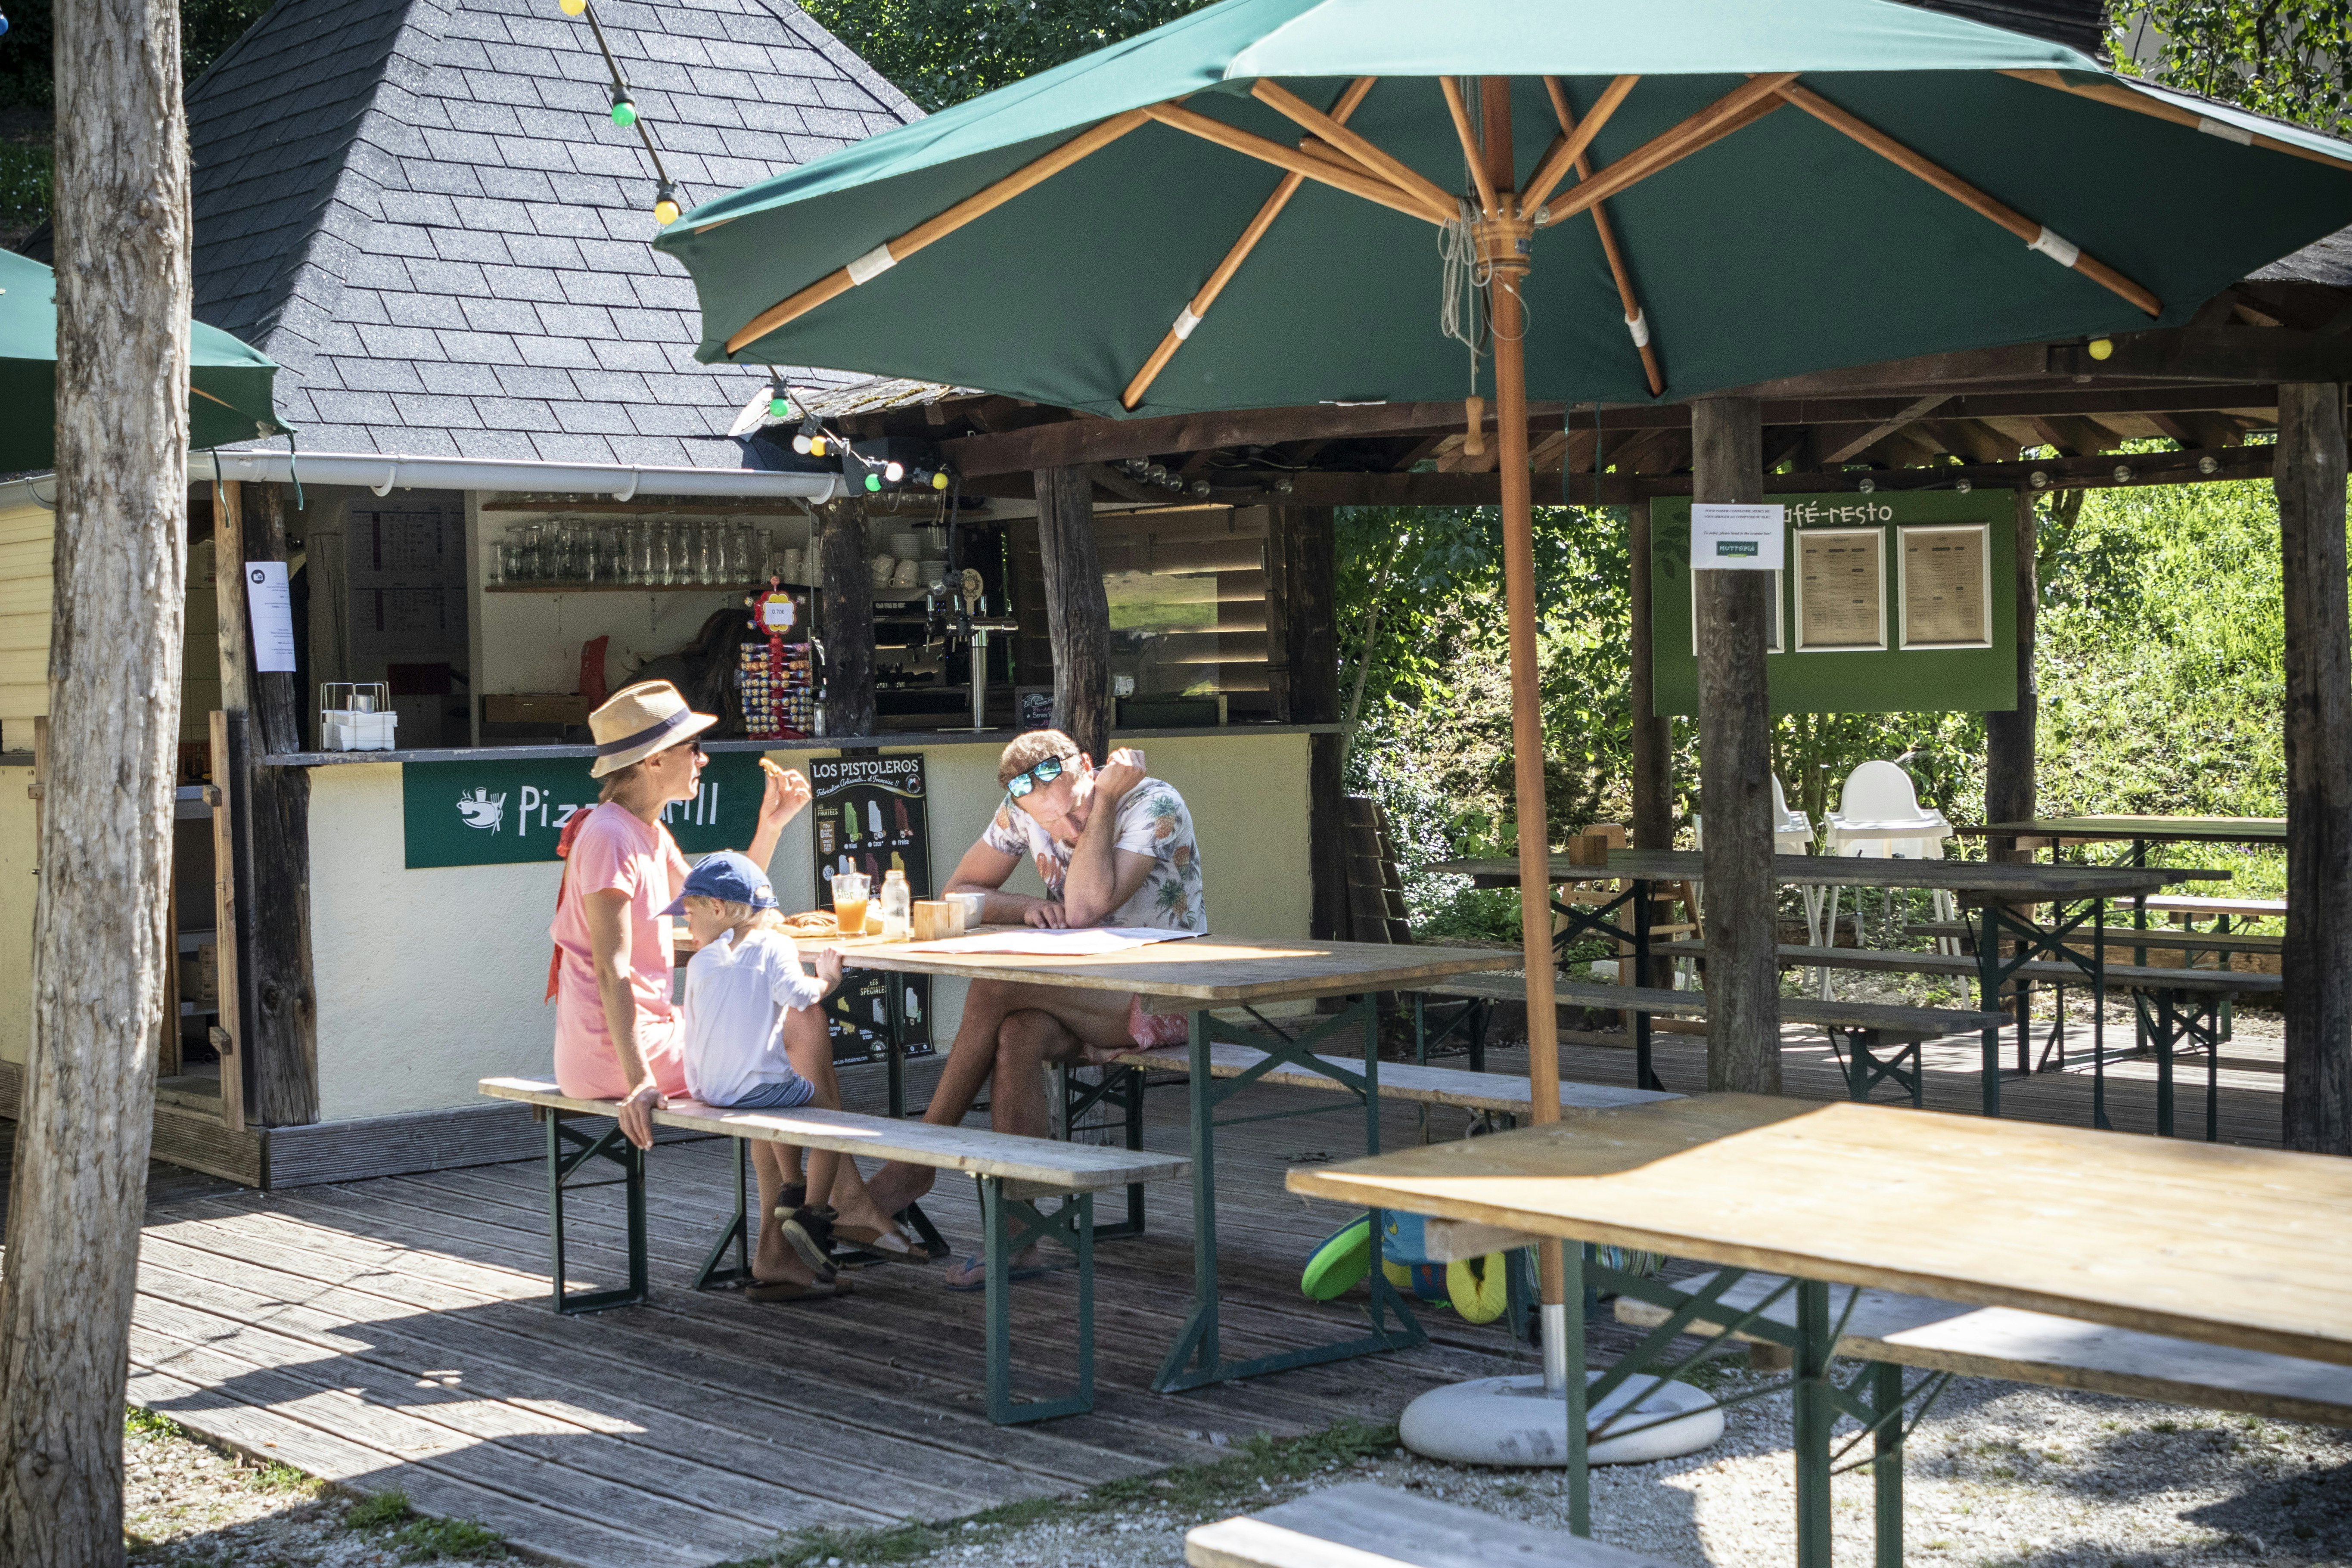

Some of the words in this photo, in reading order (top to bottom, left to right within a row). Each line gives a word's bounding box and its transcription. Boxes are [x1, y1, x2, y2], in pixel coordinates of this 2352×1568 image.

[813, 764, 837, 778] LOS
[840, 759, 919, 776] PISTOLEROS
[816, 784, 840, 797] Fabrication
[873, 775, 893, 786] Française
[658, 783, 718, 824] rill
[817, 807, 838, 816] FRUITÉES
